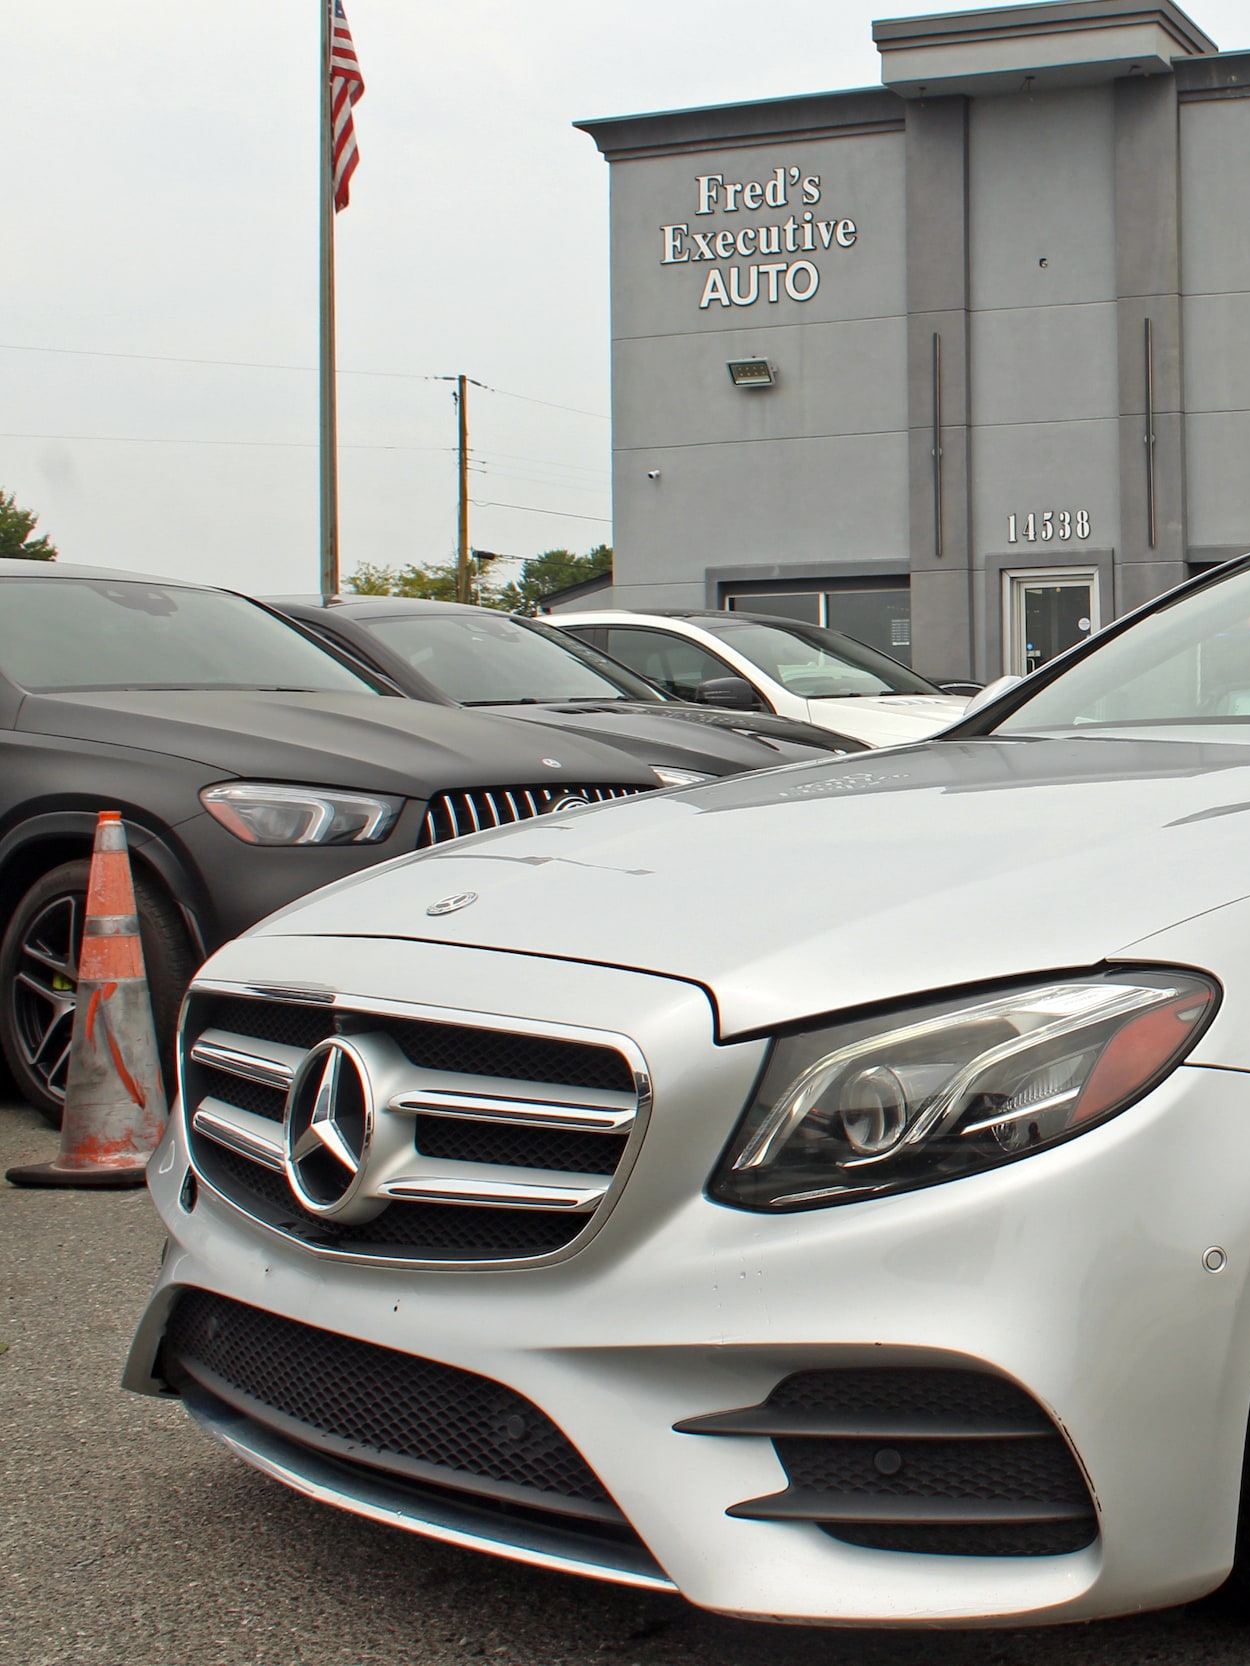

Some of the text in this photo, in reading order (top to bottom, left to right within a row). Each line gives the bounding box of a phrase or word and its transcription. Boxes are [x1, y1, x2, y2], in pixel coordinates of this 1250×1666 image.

[660, 211, 857, 264] Executive
[699, 259, 820, 309] AUTO
[1008, 509, 1091, 543] 14538
